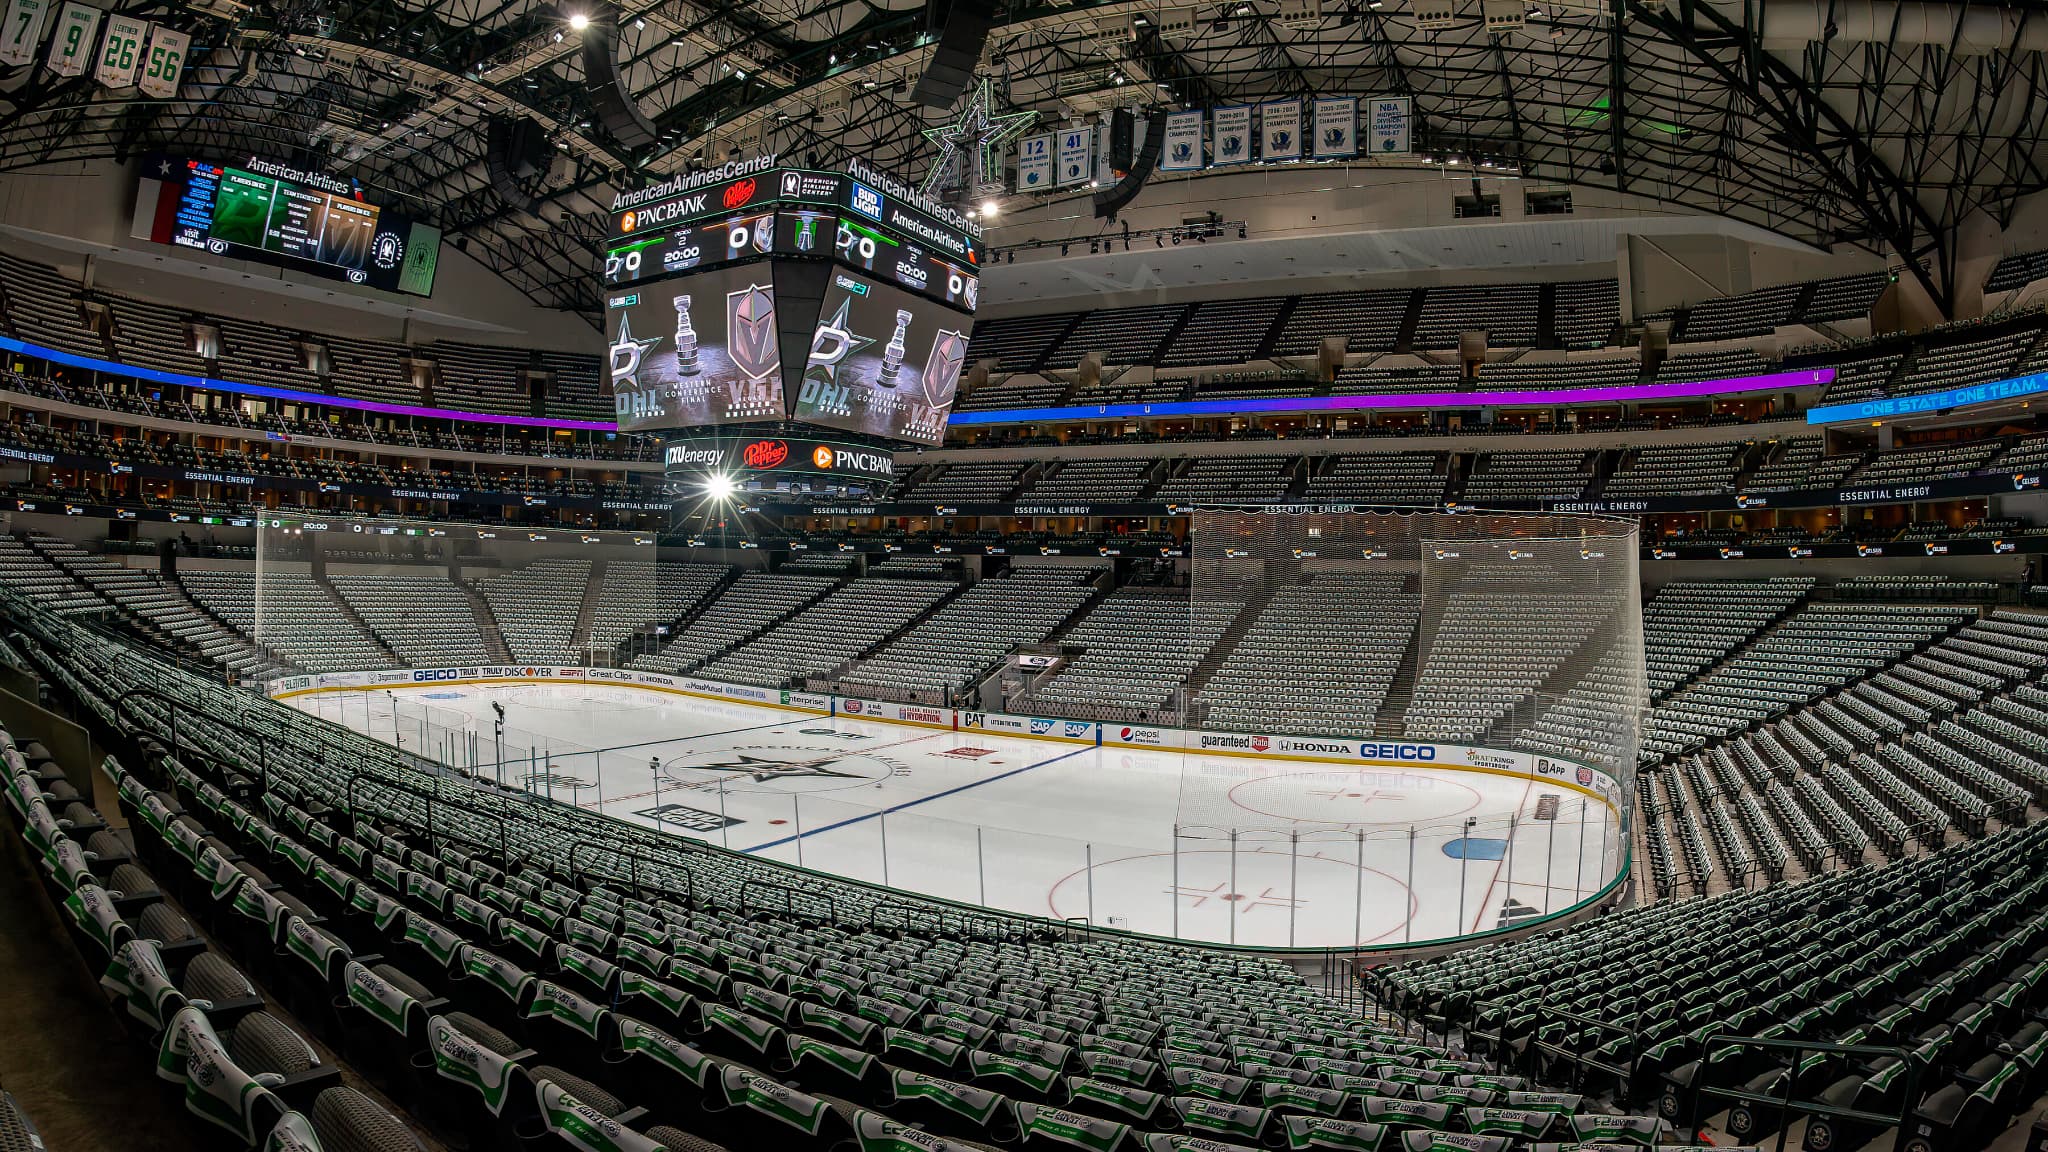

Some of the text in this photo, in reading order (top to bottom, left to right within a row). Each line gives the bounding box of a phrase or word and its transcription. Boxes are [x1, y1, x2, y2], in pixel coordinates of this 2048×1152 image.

[14, 12, 33, 44] 7
[63, 25, 83, 57] 9
[104, 35, 137, 70] 26
[147, 47, 180, 82] 56
[1379, 103, 1398, 112] NBA
[1266, 119, 1297, 128] CHAMPIONS
[1026, 140, 1044, 155] 12
[1066, 134, 1081, 148] 41
[247, 156, 350, 194] American Airlines
[612, 152, 778, 210] American Airlines Center
[802, 178, 839, 187] AMERICAN
[848, 157, 983, 238] American Airlines Center
[858, 187, 877, 204] BUD
[853, 198, 880, 218] LIGHT
[184, 229, 199, 239] visit
[729, 227, 749, 248] 0
[891, 210, 965, 254] American Airlines
[678, 236, 687, 246] 2
[664, 246, 700, 263] 20:00
[859, 237, 875, 259] 0
[625, 251, 641, 271] 0
[909, 255, 917, 263] 2
[896, 261, 927, 281] 20:00
[949, 275, 962, 294] 0
[625, 294, 637, 305] 23
[673, 379, 711, 389] WESTERN
[665, 386, 722, 398] CONFERENCE
[1861, 403, 1894, 416] ONE
[1956, 388, 1987, 404] ONE
[1990, 378, 2040, 398] TEAM.
[681, 396, 706, 404] FINAL
[857, 394, 907, 411] CONFERENCE
[759, 440, 775, 454] Dr
[28, 453, 55, 463] ENERGY
[747, 444, 786, 466] Pepper
[185, 471, 255, 485] ESSENTIAL ENERGY
[2022, 476, 2039, 486] CELSIUS
[391, 489, 460, 500] ESSENTIAL ENERGY
[1840, 486, 1930, 502] ESSENTIAL ENERGY
[1014, 506, 1090, 514] ESSENTIAL ENERGY
[1264, 505, 1355, 513] ESSENTIAL ENERGY
[1553, 502, 1649, 511] ESSENTIAL ENERGY
[303, 522, 328, 530] 20:00
[413, 668, 457, 681] GEICO
[459, 667, 479, 677] TRULY
[482, 667, 503, 676] TRULY
[504, 667, 552, 677] DISCOVER
[559, 669, 583, 677] ESPN
[589, 668, 633, 682] Great Clips
[646, 676, 674, 686] HONDA
[690, 681, 723, 694] MassMutual
[782, 694, 824, 706] enterprise
[906, 712, 942, 723] HYDRATION.
[965, 712, 985, 728] CAT
[1031, 722, 1050, 732] SAP
[1065, 724, 1085, 735] SAP
[1135, 729, 1160, 738] pepsi
[1201, 735, 1249, 748] guaranteed
[1292, 742, 1352, 754] HONDA
[1360, 743, 1436, 760] GEICO
[1550, 763, 1565, 775] App
